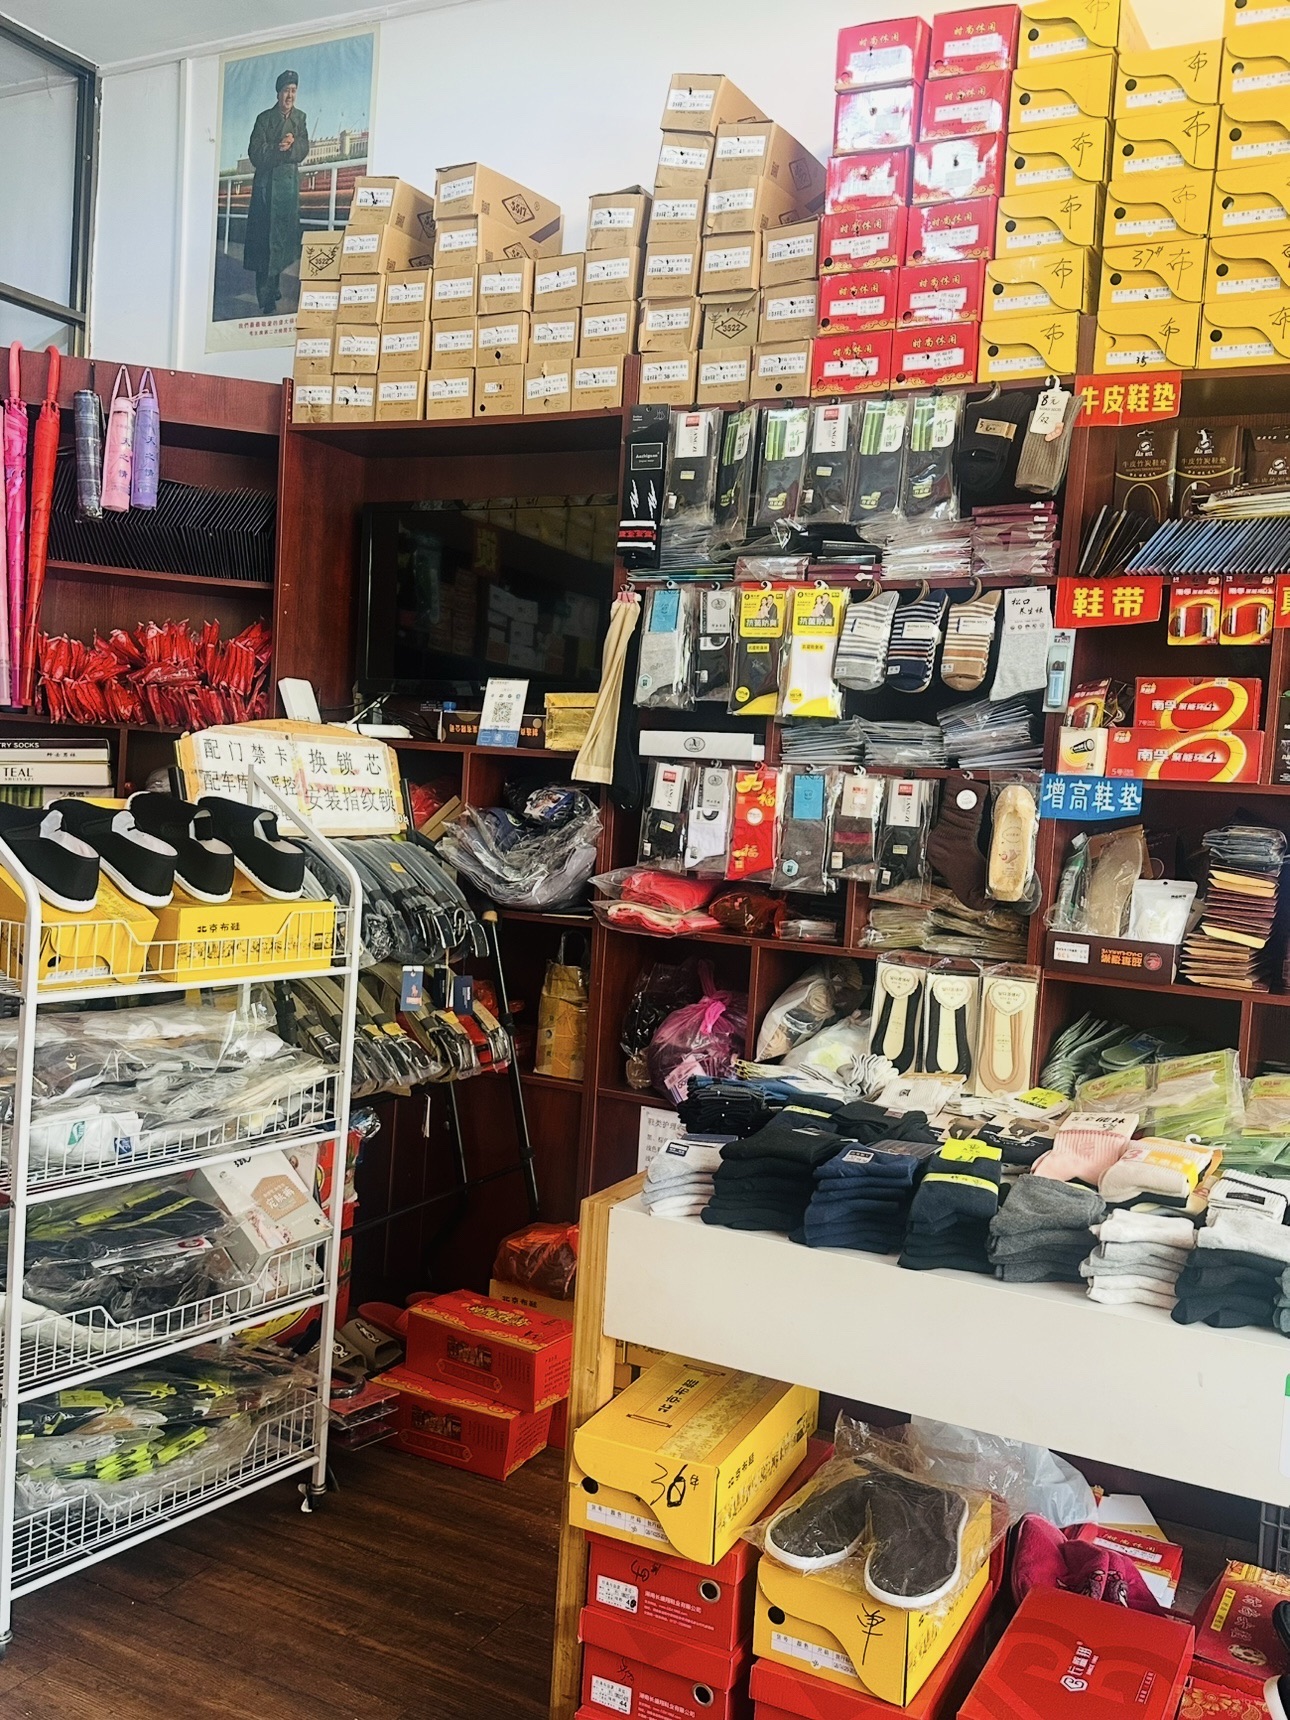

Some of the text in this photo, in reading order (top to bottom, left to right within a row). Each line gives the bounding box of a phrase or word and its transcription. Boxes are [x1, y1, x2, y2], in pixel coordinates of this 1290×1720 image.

[1183, 50, 1208, 82] 布
[1070, 132, 1094, 167] 布
[1182, 111, 1211, 165] 布
[1060, 194, 1082, 229] 布
[1044, 258, 1073, 289] 布
[1167, 248, 1193, 290] 布
[722, 324, 741, 332] 3522
[912, 333, 958, 348] 时尚休闲
[1040, 323, 1064, 355] 布
[1158, 317, 1180, 354] 布
[1081, 382, 1176, 415] 牛皮鞋垫
[1122, 458, 1168, 468] 牛皮竹炭鞋垫
[1181, 456, 1227, 465] 牛皮竹炭鞋垫
[1072, 586, 1144, 618] 鞋带
[1151, 699, 1178, 711] 南孚
[203, 738, 288, 767] 配门禁卡
[308, 748, 382, 776] 换锁芯
[1137, 748, 1220, 763] 南孚 聚能环4
[4, 767, 32, 777] TEAL
[203, 770, 298, 796] 配车库遥控
[308, 786, 396, 812] 安装指纹锁
[1043, 778, 1142, 812] 增高鞋垫
[197, 922, 240, 934] 北京布鞋
[502, 1296, 538, 1308] 北京布鞋
[658, 1378, 700, 1412] 北京布鞋
